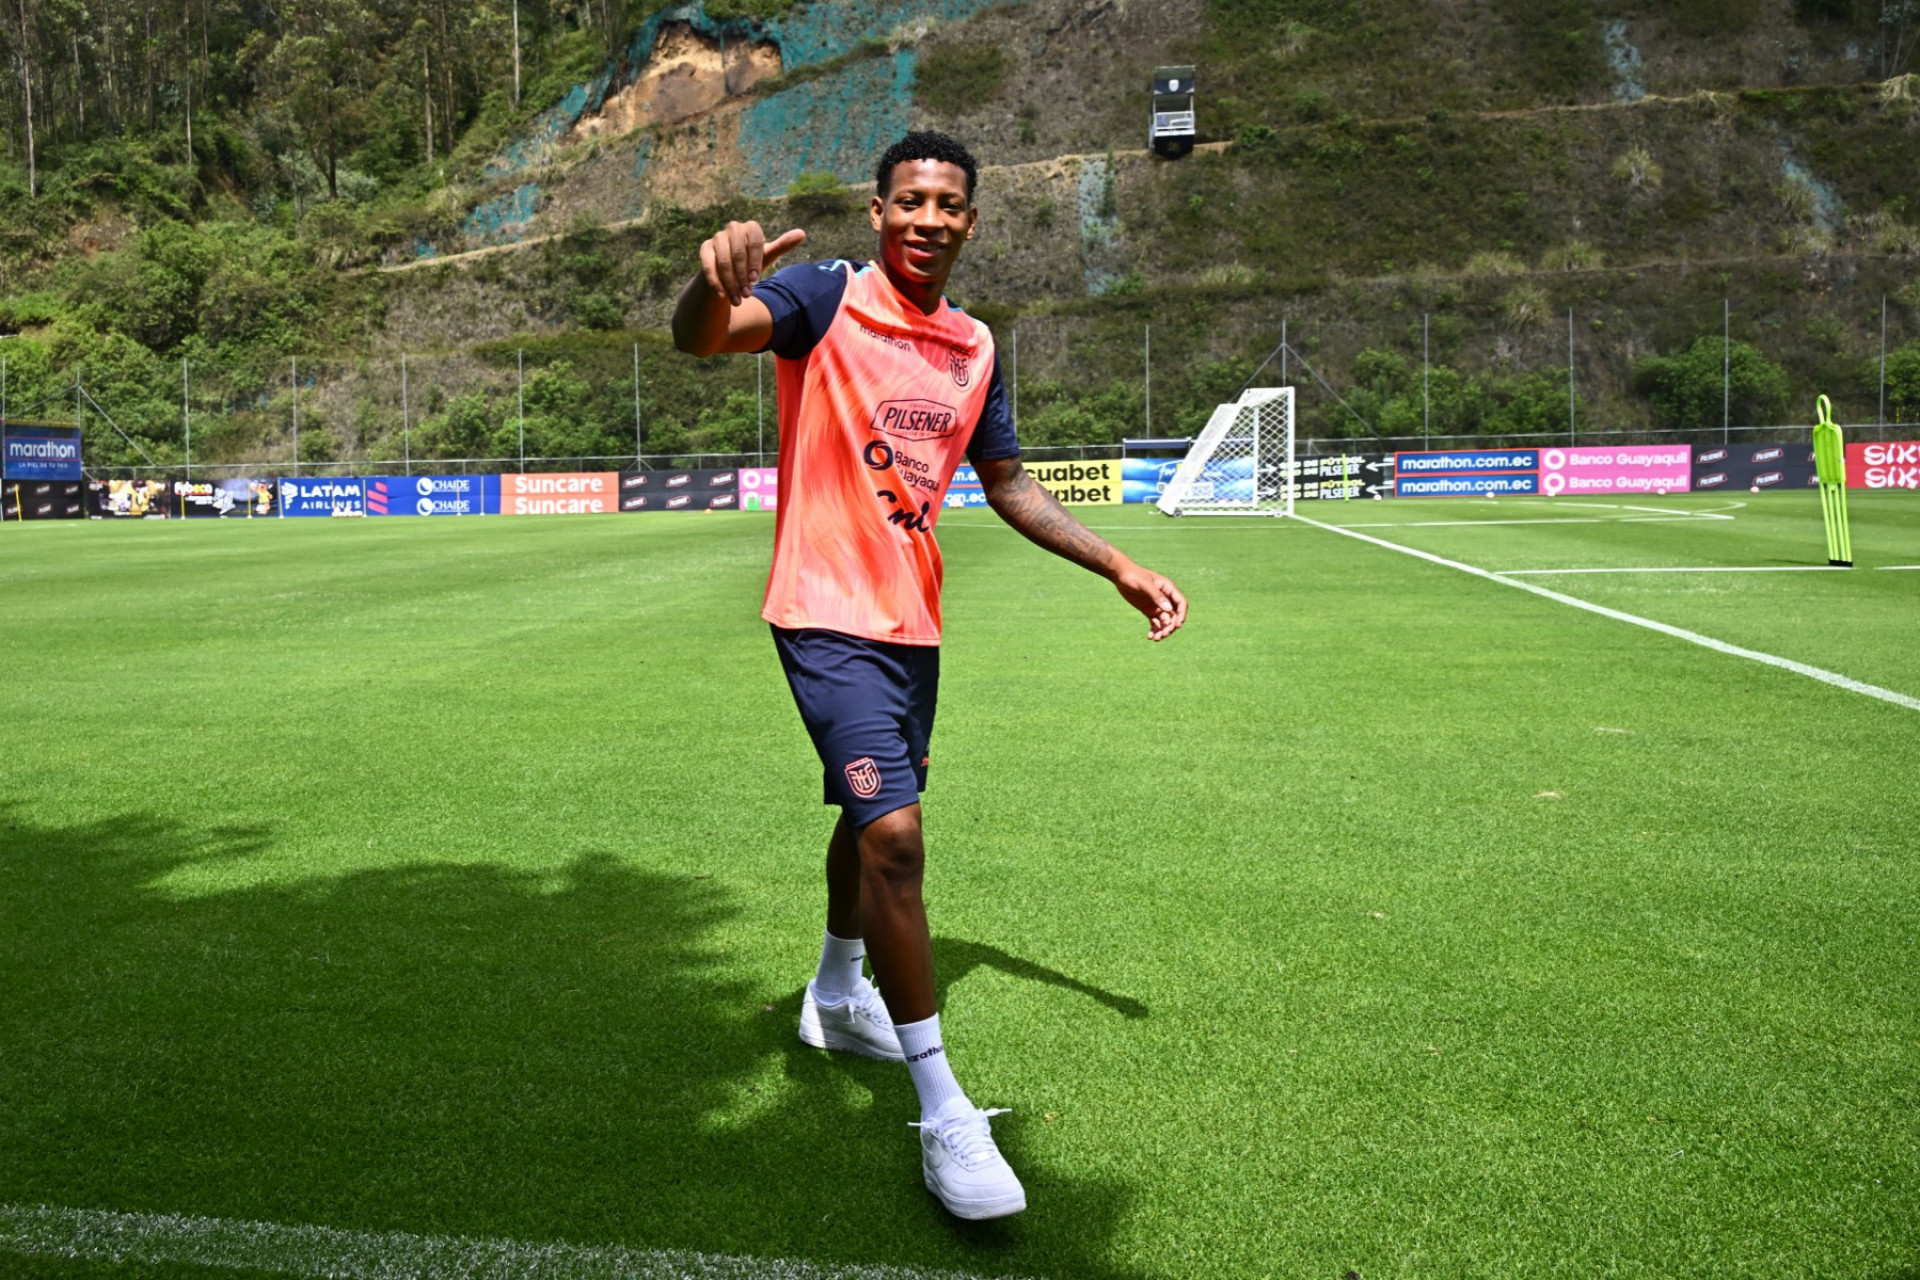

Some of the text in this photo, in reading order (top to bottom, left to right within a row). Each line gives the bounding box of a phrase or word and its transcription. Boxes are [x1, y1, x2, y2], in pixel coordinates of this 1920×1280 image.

[860, 325, 911, 352] marathon
[883, 407, 952, 433] PILSENER
[10, 441, 76, 458] marathon
[895, 451, 929, 473] Banco
[1402, 456, 1532, 470] marathon.com.ec
[1570, 452, 1687, 467] Banco Guayaquil
[301, 485, 361, 497] LATAM
[515, 476, 604, 493] Suncare
[1402, 479, 1532, 493] marathon.com.ec
[1569, 476, 1687, 490] Banco Guayaquil
[301, 501, 361, 510] AIRLINES
[515, 496, 604, 515] Suncare
